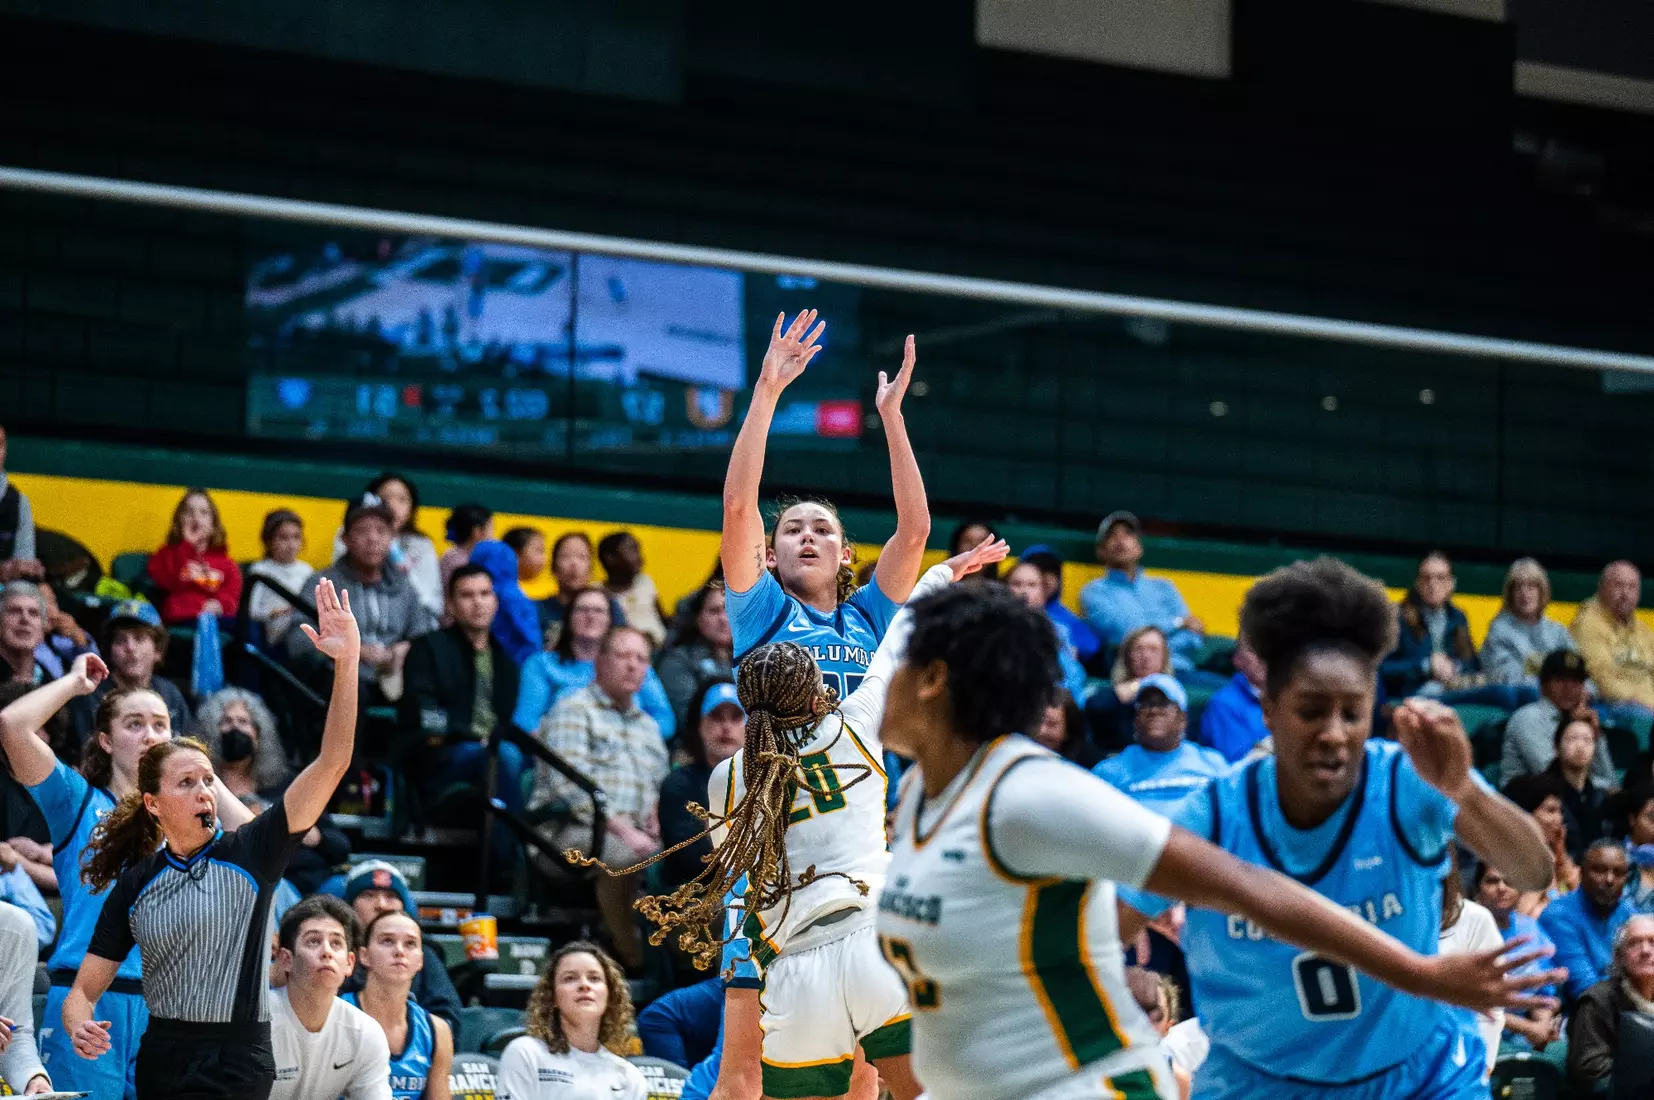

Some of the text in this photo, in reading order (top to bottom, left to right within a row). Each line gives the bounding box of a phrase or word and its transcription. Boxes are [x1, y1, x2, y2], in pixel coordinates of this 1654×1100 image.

[1227, 892, 1402, 940] COIA
[1291, 950, 1362, 1022] 0
[461, 1062, 490, 1074] SAN
[388, 1075, 427, 1091] MBI
[448, 1073, 499, 1091] RANCI
